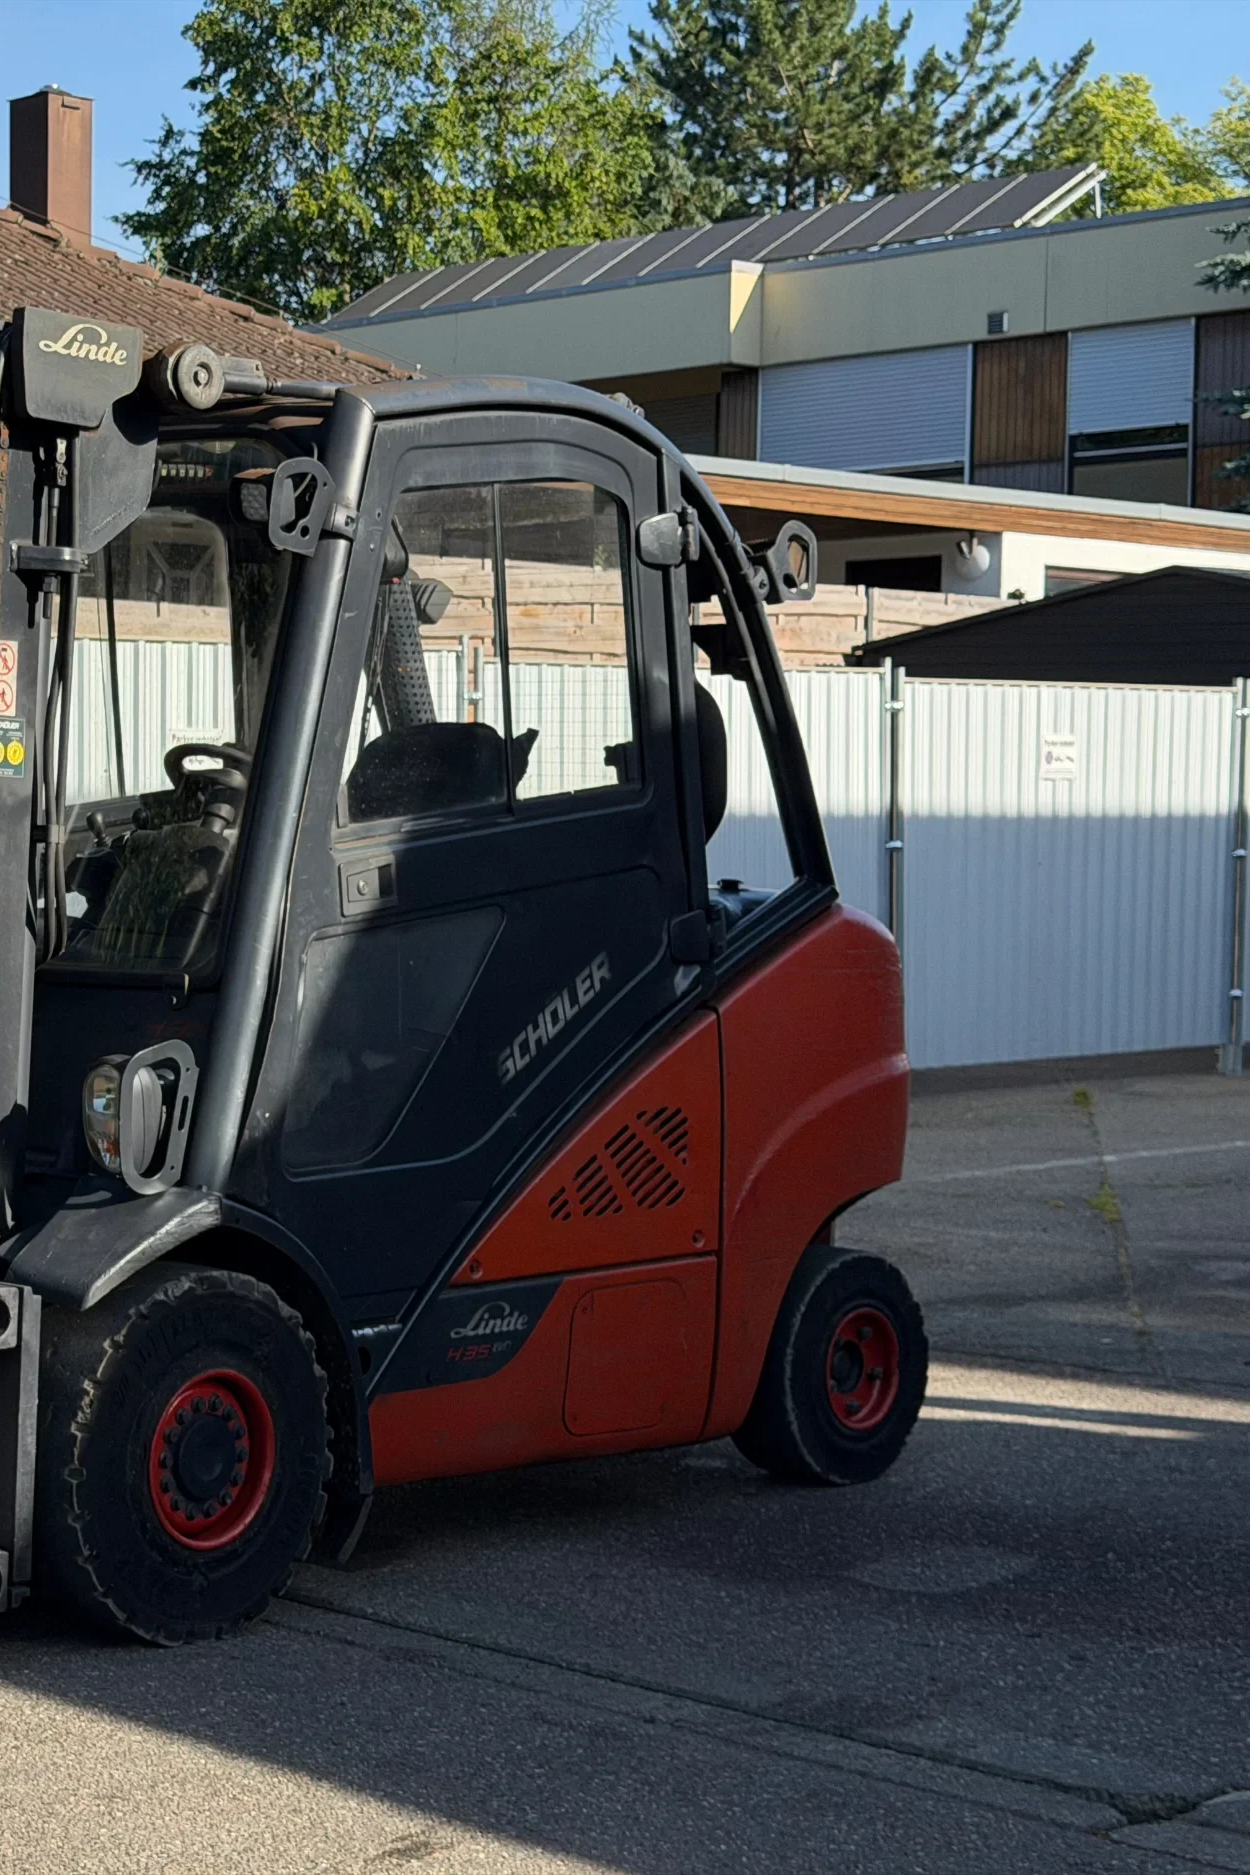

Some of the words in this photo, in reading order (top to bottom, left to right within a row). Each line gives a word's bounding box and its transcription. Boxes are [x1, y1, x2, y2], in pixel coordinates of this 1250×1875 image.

[38, 323, 127, 366] Linde
[450, 1301, 529, 1339] Linde
[446, 1344, 492, 1363] H35
